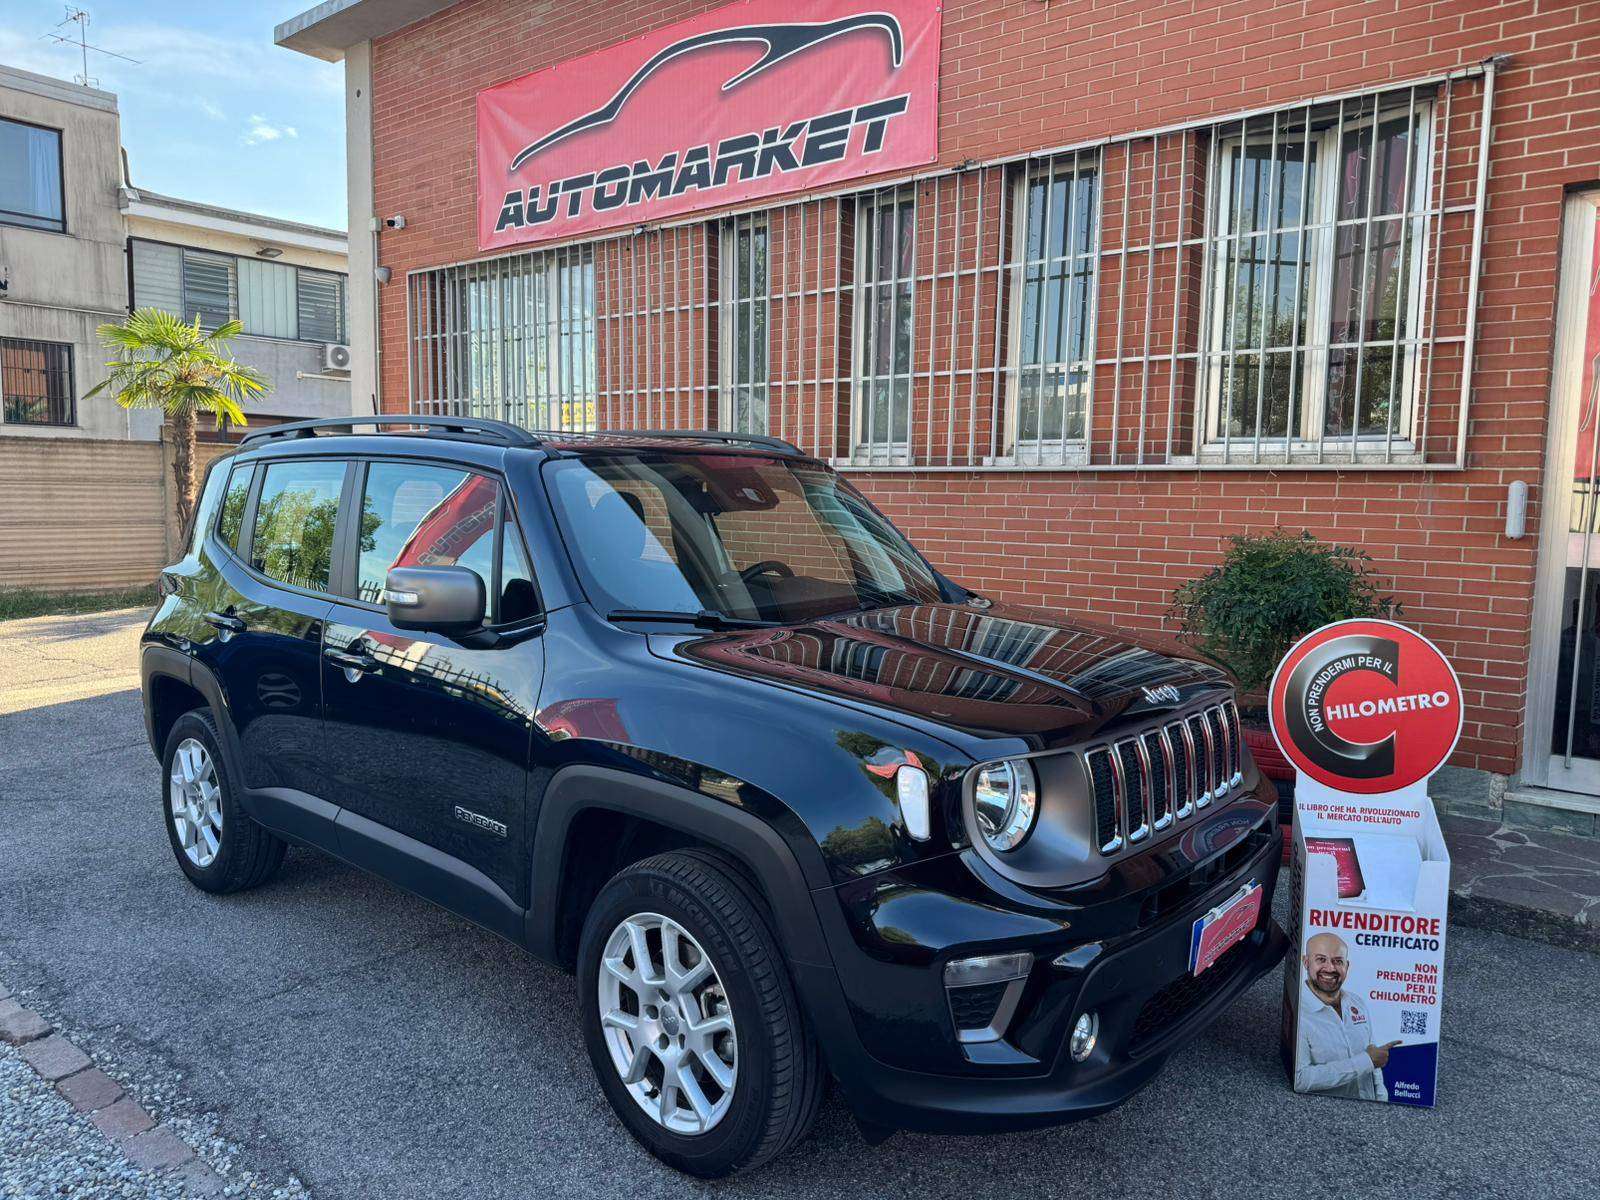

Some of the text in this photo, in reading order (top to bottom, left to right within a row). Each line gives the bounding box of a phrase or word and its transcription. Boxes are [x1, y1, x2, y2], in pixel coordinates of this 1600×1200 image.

[494, 93, 911, 233] AUTOMARKET
[1308, 656, 1393, 733] NON PRENDERMI PER IL
[1298, 803, 1306, 811] IL
[1306, 803, 1328, 812] LIBRO
[1330, 805, 1345, 813] CHE
[1360, 807, 1421, 819] RIVOLUZIONATO
[1317, 812, 1402, 826] IL MERCATO DELL'AUTO
[1309, 909, 1440, 937] RIVENDITORE
[1355, 933, 1440, 952] CERTIFICATO
[1414, 963, 1438, 974] NON
[1376, 970, 1438, 985] PRENDERMI
[1406, 982, 1438, 995] PER IL
[1369, 990, 1437, 1006] CHILOMETRO
[1394, 1081, 1420, 1091] Alfredo
[1394, 1089, 1421, 1099] Bellucci
